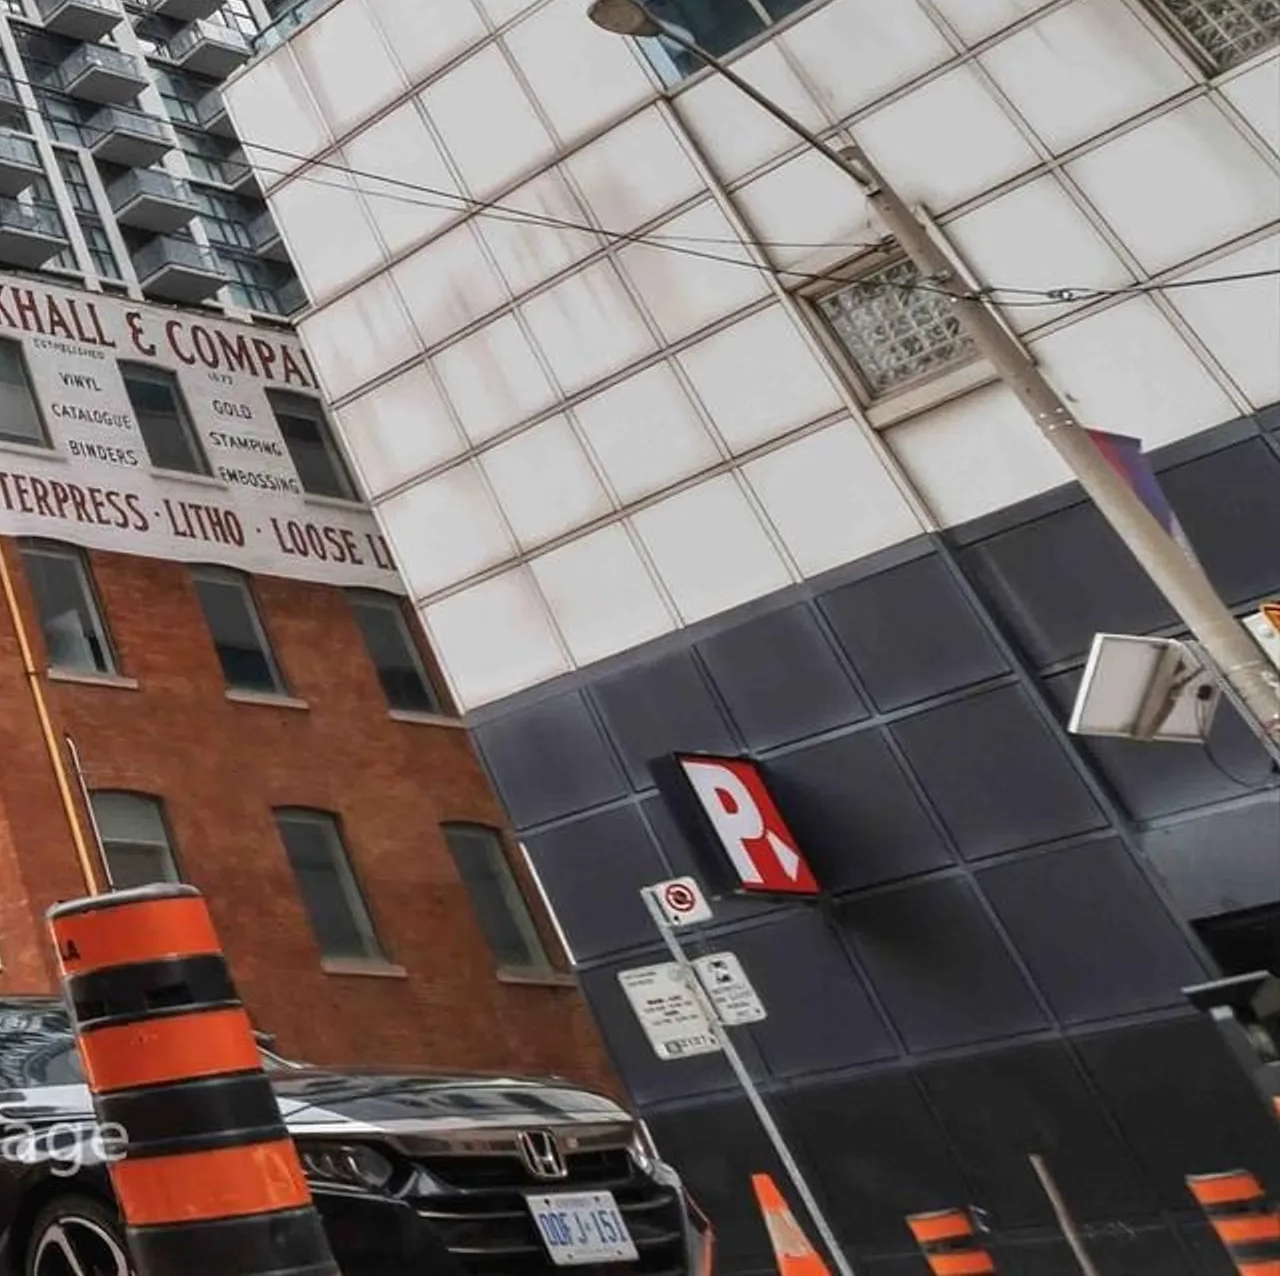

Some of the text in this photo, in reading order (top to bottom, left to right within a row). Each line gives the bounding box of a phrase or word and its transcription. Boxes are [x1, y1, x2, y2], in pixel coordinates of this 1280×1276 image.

[58, 371, 102, 392] VINYL
[51, 403, 132, 430] CATALOGUE
[212, 399, 254, 420] GOLD
[68, 439, 139, 466] BINDERS
[208, 431, 283, 457] STAMPING
[217, 466, 301, 495] EMBOSSING
[163, 498, 246, 548] LITHO
[269, 517, 365, 566] LOOSE
